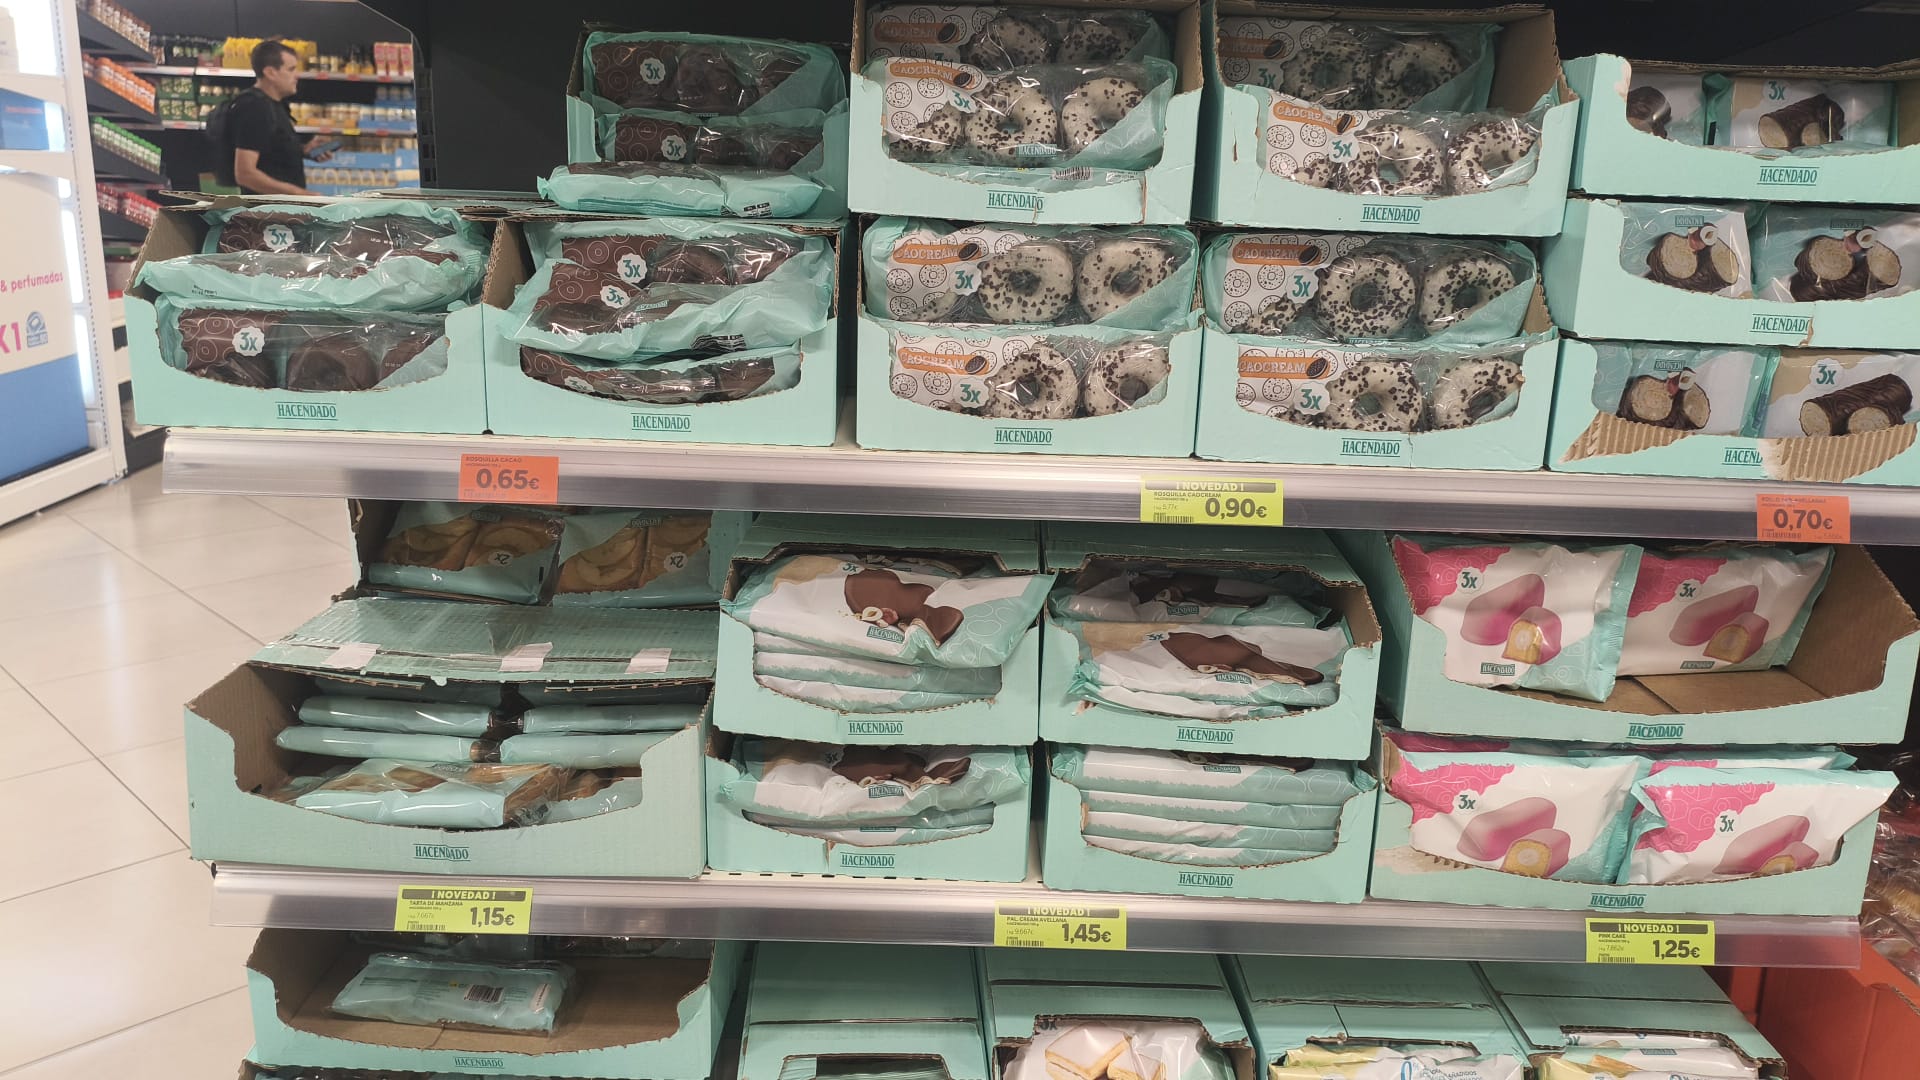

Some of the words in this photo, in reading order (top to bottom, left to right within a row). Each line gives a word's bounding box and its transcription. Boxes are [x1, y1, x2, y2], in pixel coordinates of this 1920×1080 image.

[645, 62, 660, 80] 3x
[1768, 81, 1785, 100] 3x
[954, 93, 971, 110] 3x
[668, 140, 683, 157] 3x
[1333, 140, 1353, 158] 3x
[1759, 168, 1818, 183] HACENDADO
[987, 192, 1044, 210] HACENDADO
[1363, 206, 1420, 222] HACENDADO
[270, 228, 287, 246] 3x
[1237, 248, 1299, 260] CAOCREAM
[623, 259, 641, 278] 3x
[11, 272, 64, 294] perfumadas
[955, 270, 973, 289] 3x
[1292, 275, 1309, 296] 3x
[606, 288, 624, 305] 3x
[240, 332, 257, 351] 3x
[899, 352, 964, 369] CAOCREAM
[1239, 362, 1305, 375] CAOCREAM
[1817, 365, 1836, 385] 3x
[960, 384, 980, 403] 3x
[1300, 389, 1321, 410] 3x
[278, 404, 336, 418] HACENDADO
[633, 415, 691, 430] HACENDADO
[995, 429, 1052, 444] HACENDADO
[1342, 440, 1400, 455] HACENDADO
[476, 468, 539, 490] 0,65€
[1205, 498, 1267, 519] 0,90€
[1773, 509, 1833, 531] 0,70€
[494, 553, 511, 565] 2x
[669, 555, 684, 568] 2x
[1460, 571, 1478, 589] 3x
[1679, 582, 1697, 599] 3x
[849, 721, 903, 734] HACENDADO
[1178, 728, 1233, 743] HACENDADO
[1628, 725, 1683, 738] HACENDADO
[1458, 794, 1476, 811] 3x
[1719, 815, 1735, 833] 3x
[415, 845, 469, 859] HACENDADO
[842, 855, 895, 867] HACENDADO
[1179, 873, 1233, 887] HACENDADO
[1590, 893, 1644, 907] HACENDADO
[470, 906, 515, 928] 1,15€
[1061, 923, 1111, 944] 1,45€
[1653, 940, 1700, 960] 1,25€
[455, 1057, 503, 1067] HACENDADO
